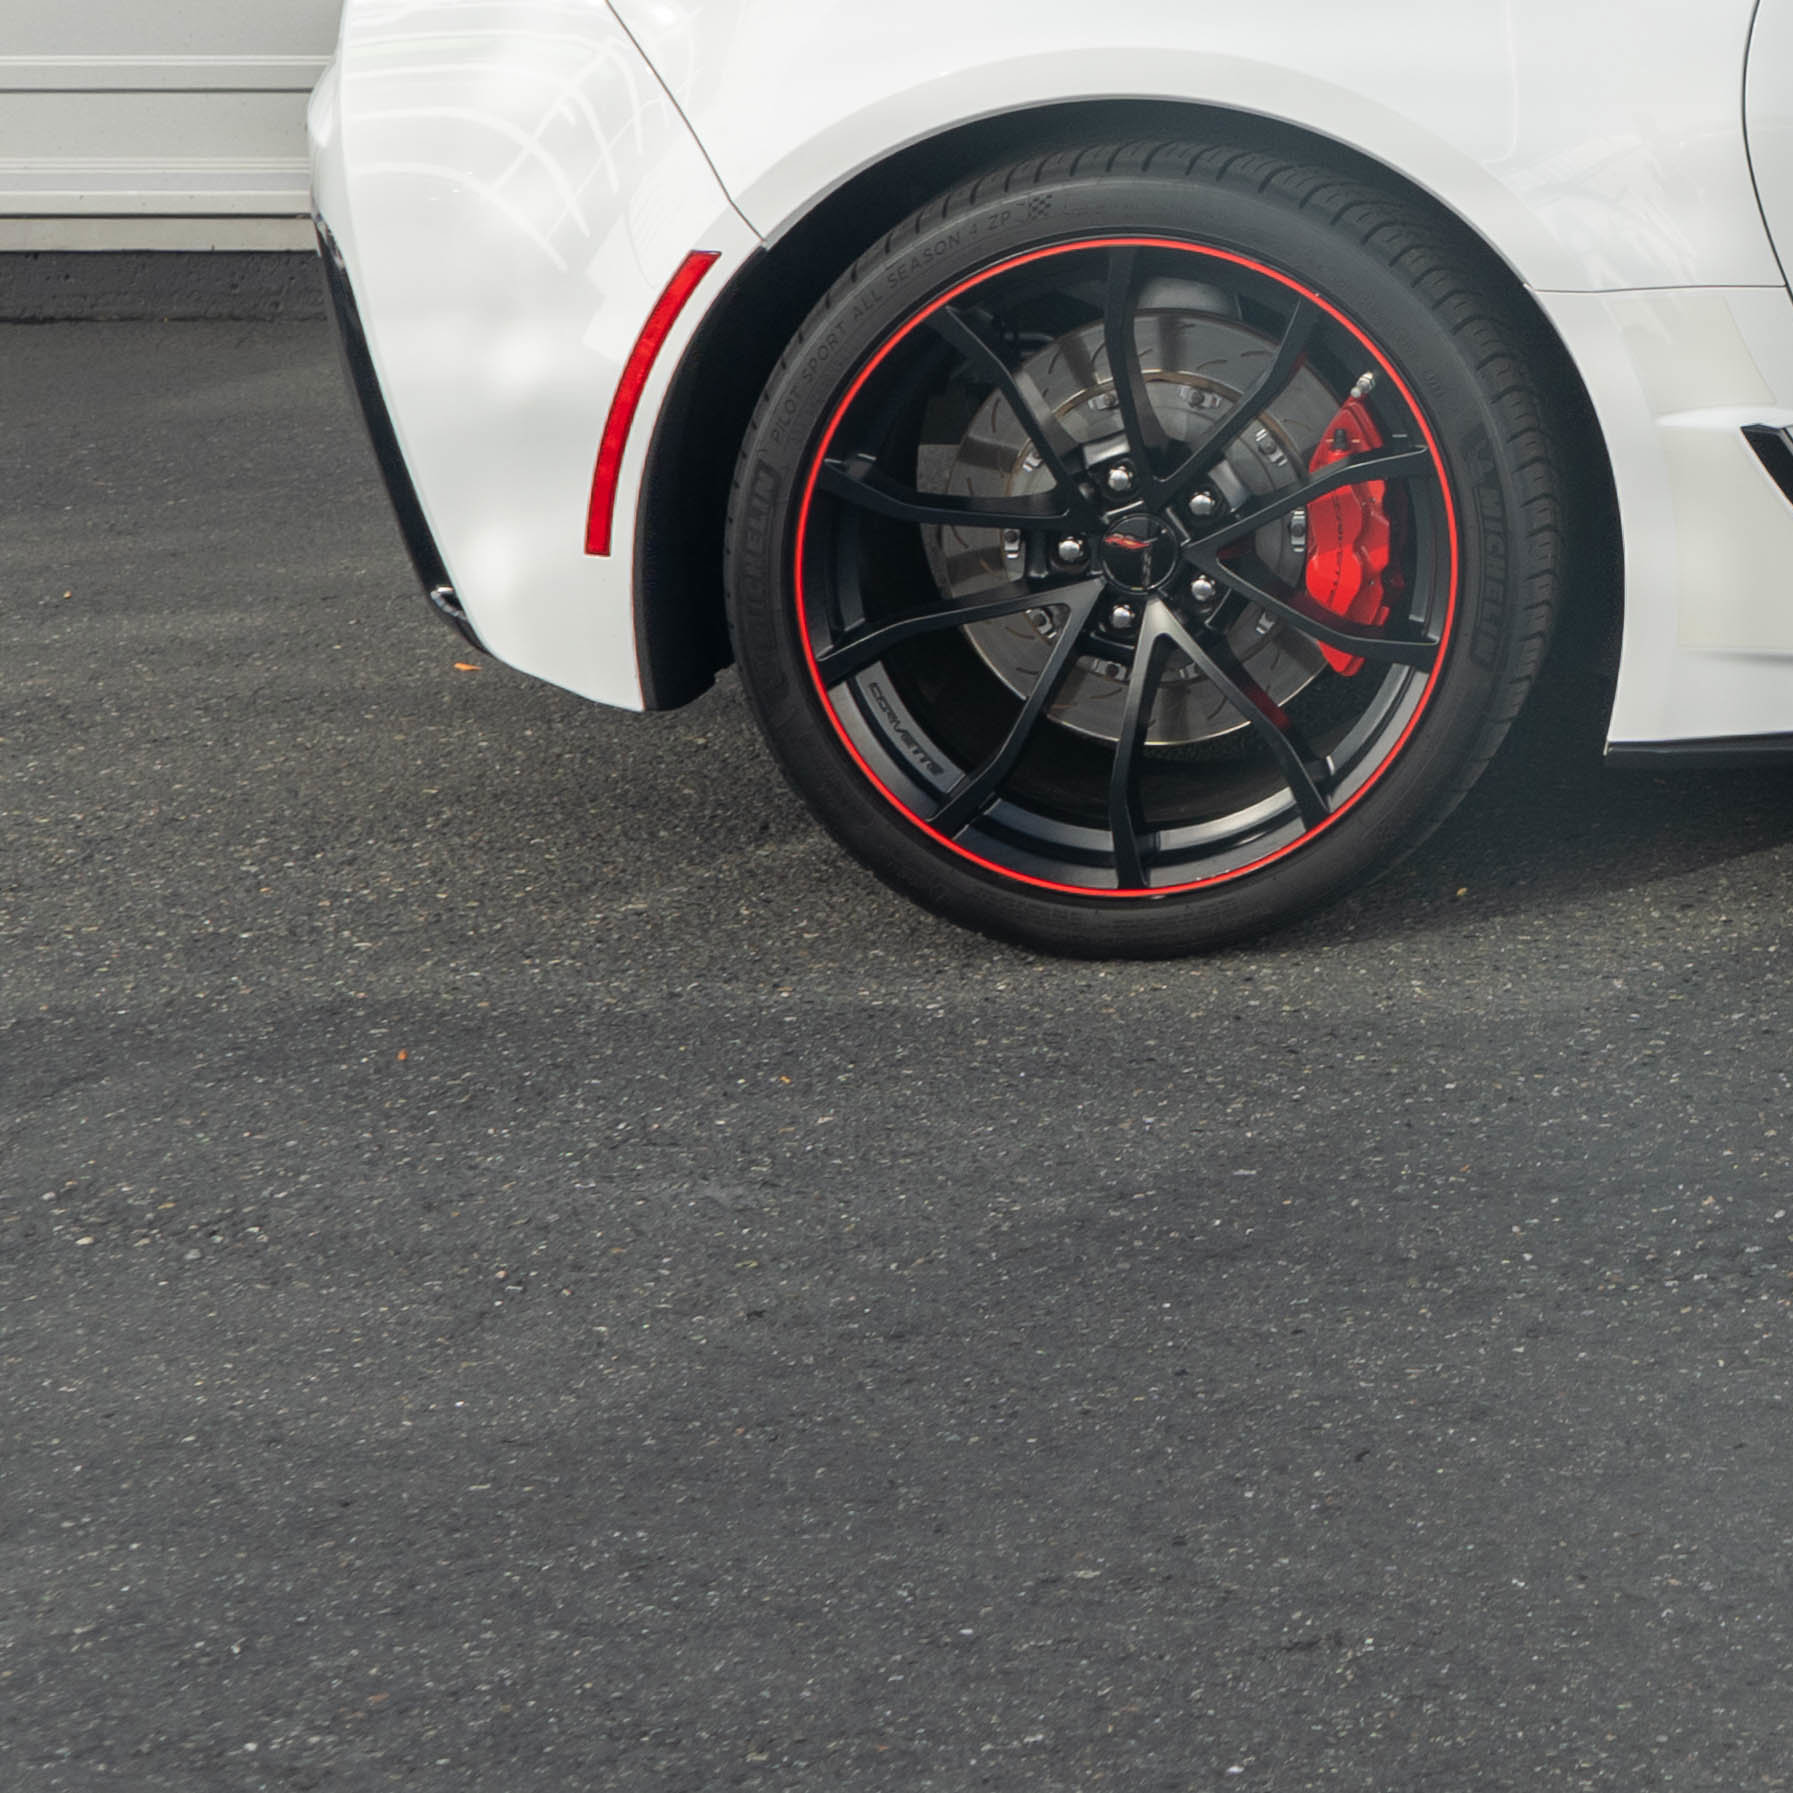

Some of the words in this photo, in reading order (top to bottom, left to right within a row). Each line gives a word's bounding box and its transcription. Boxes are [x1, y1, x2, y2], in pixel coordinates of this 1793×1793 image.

[770, 386, 804, 444] PILOT
[802, 321, 846, 383] SPORT
[853, 290, 883, 322] ALL
[887, 231, 961, 289] SEASON
[988, 210, 1011, 231] ZP
[869, 682, 944, 775] CORVETTE
